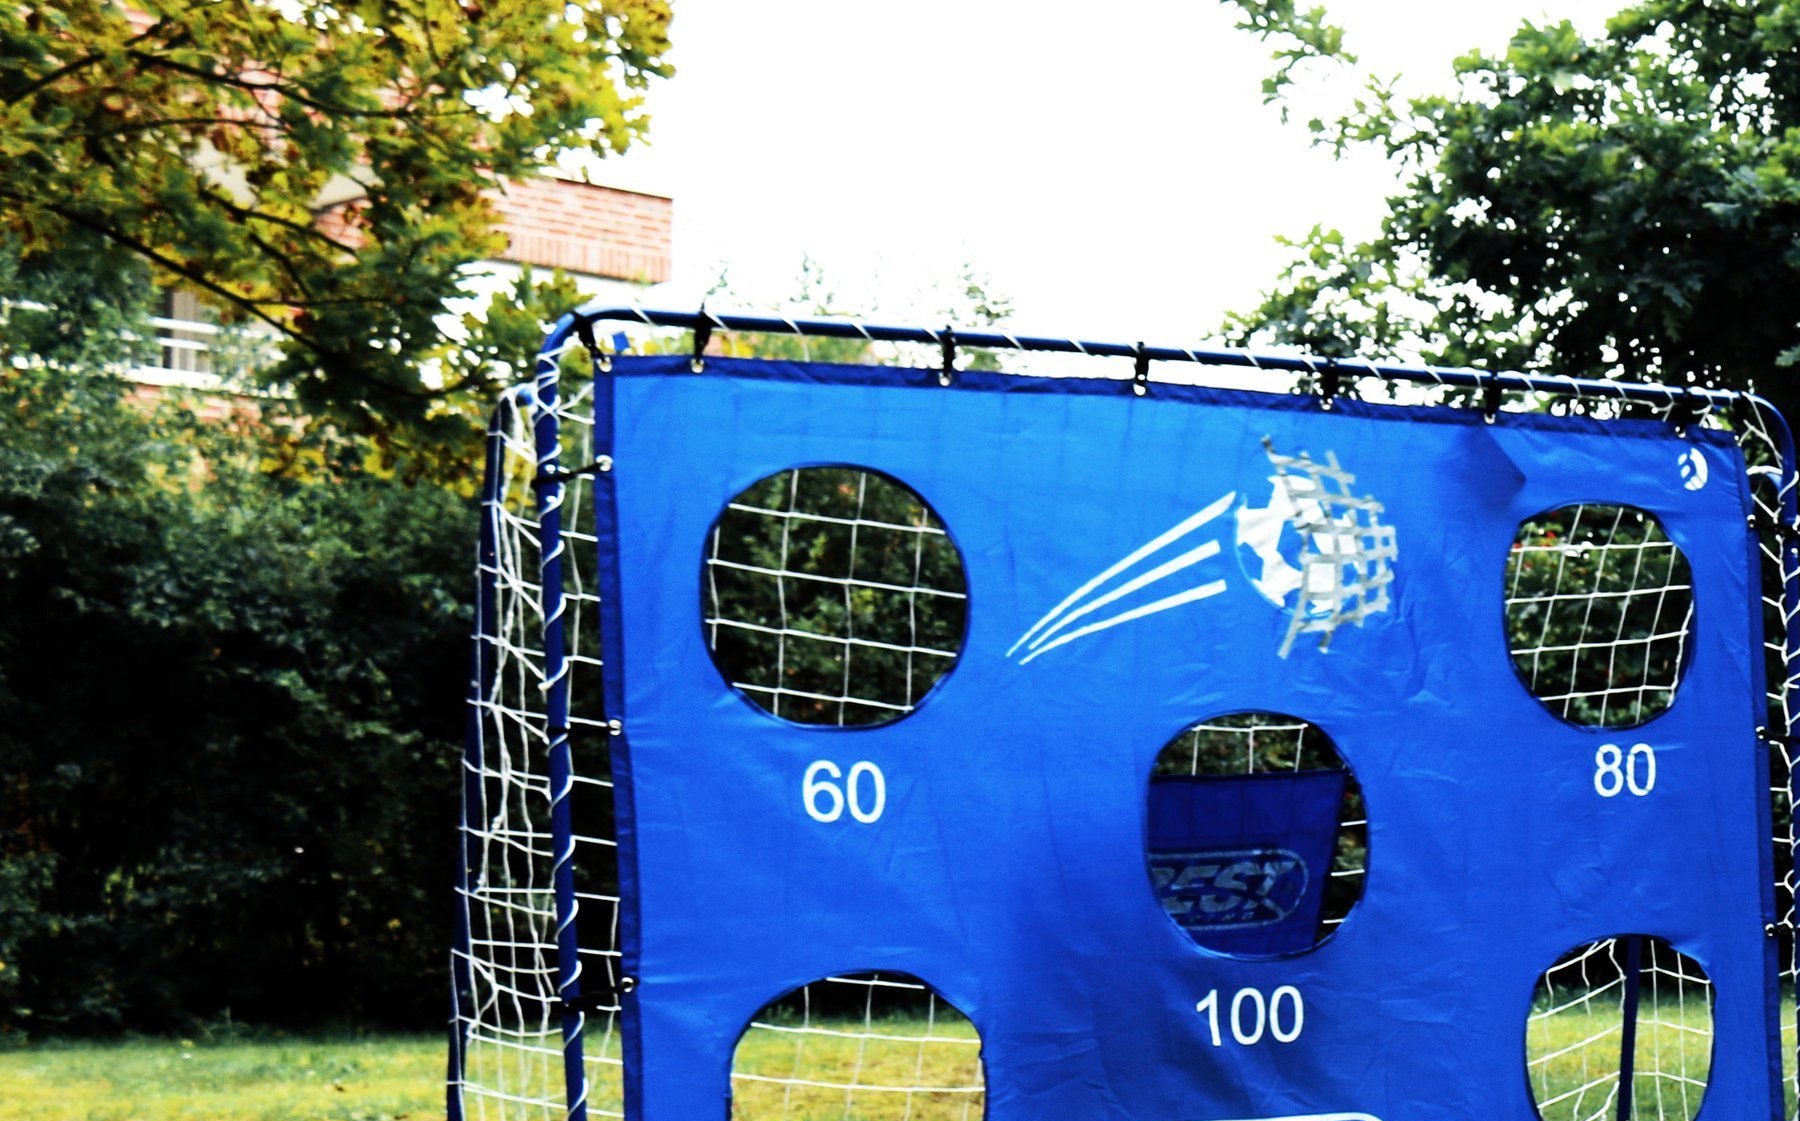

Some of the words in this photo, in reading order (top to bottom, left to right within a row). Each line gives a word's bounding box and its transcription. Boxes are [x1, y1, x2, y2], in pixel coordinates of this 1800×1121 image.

[802, 760, 886, 824] 60
[1594, 743, 1656, 798] 80
[1196, 985, 1304, 1047] 100
